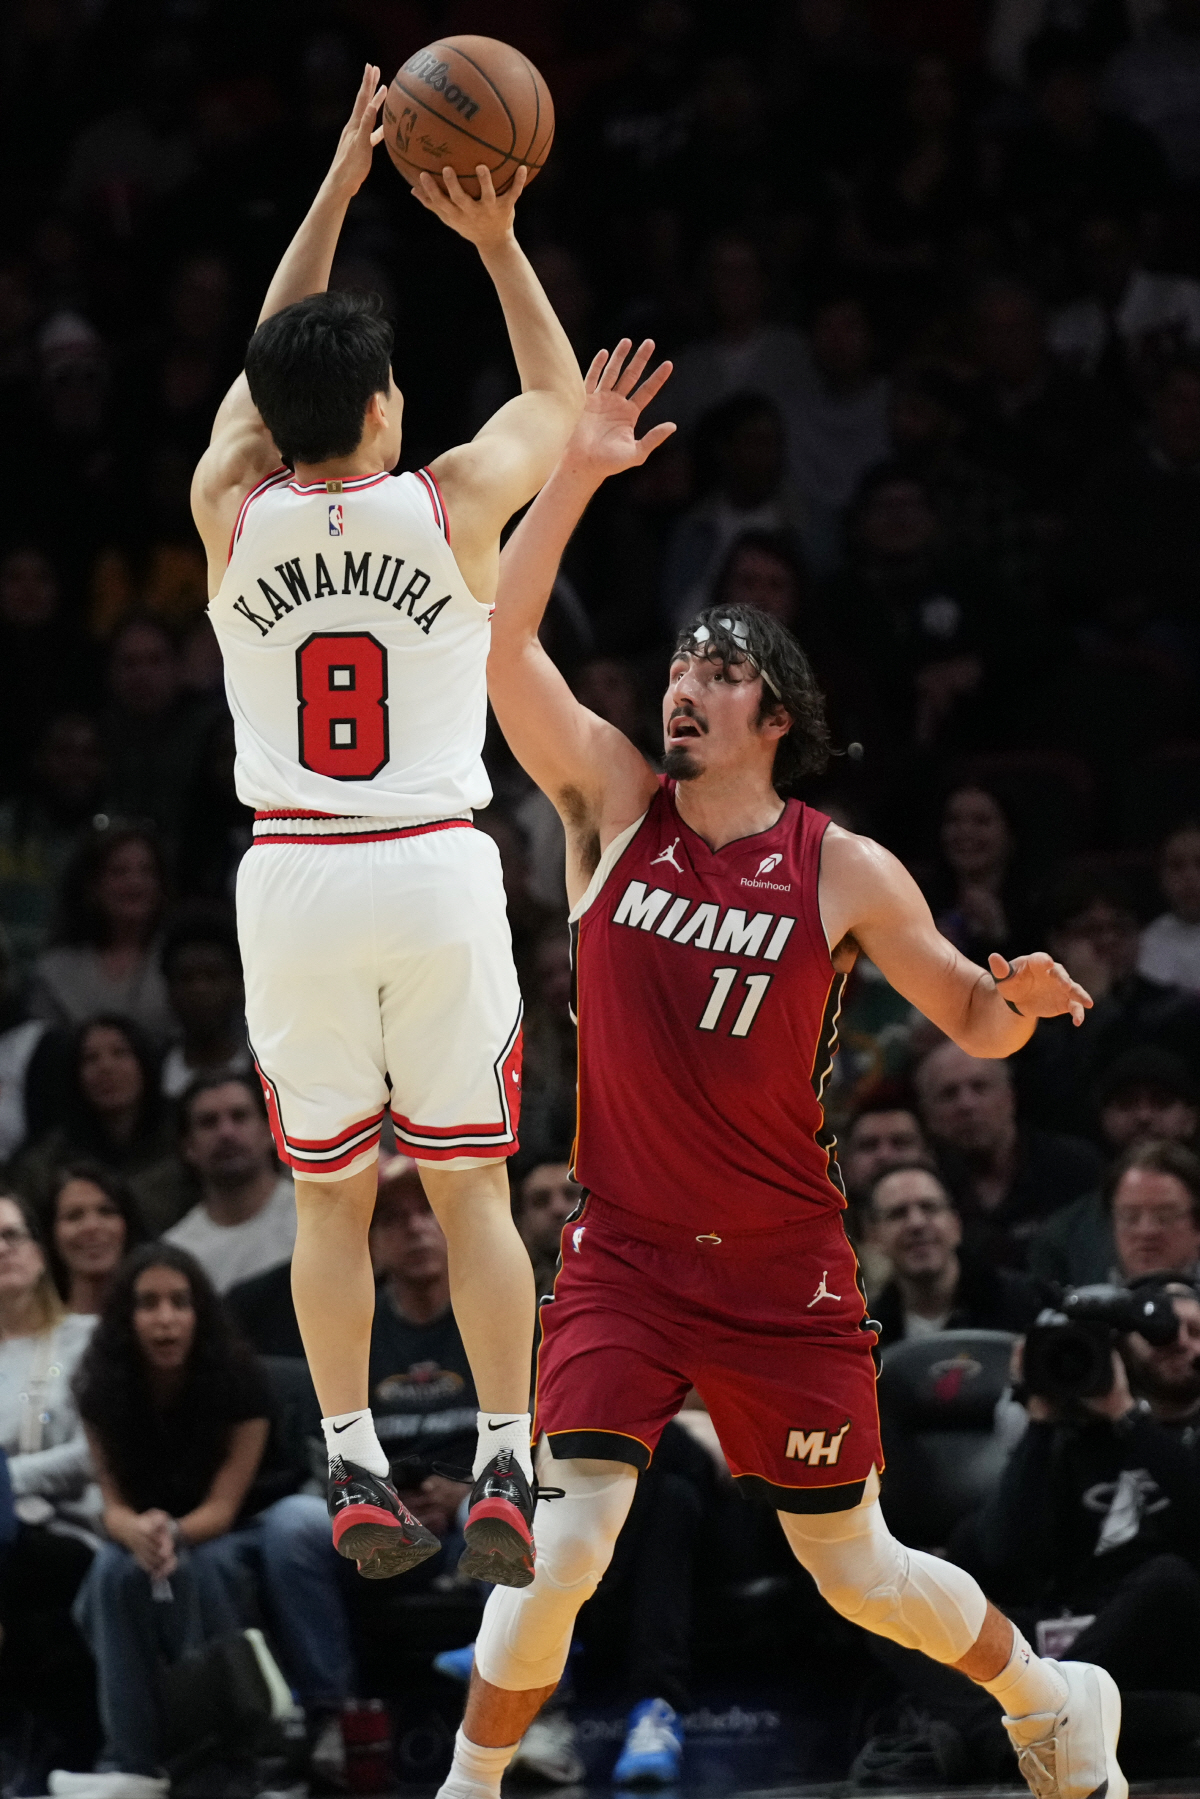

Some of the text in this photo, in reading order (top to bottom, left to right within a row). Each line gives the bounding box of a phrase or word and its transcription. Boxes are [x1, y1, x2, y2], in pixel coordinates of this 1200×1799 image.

[404, 52, 480, 121] Wilson
[233, 551, 452, 637] KAWAMURA
[295, 631, 390, 781] 8
[612, 880, 797, 961] MIAMI
[740, 878, 791, 892] Robinhood
[695, 966, 775, 1039] 11
